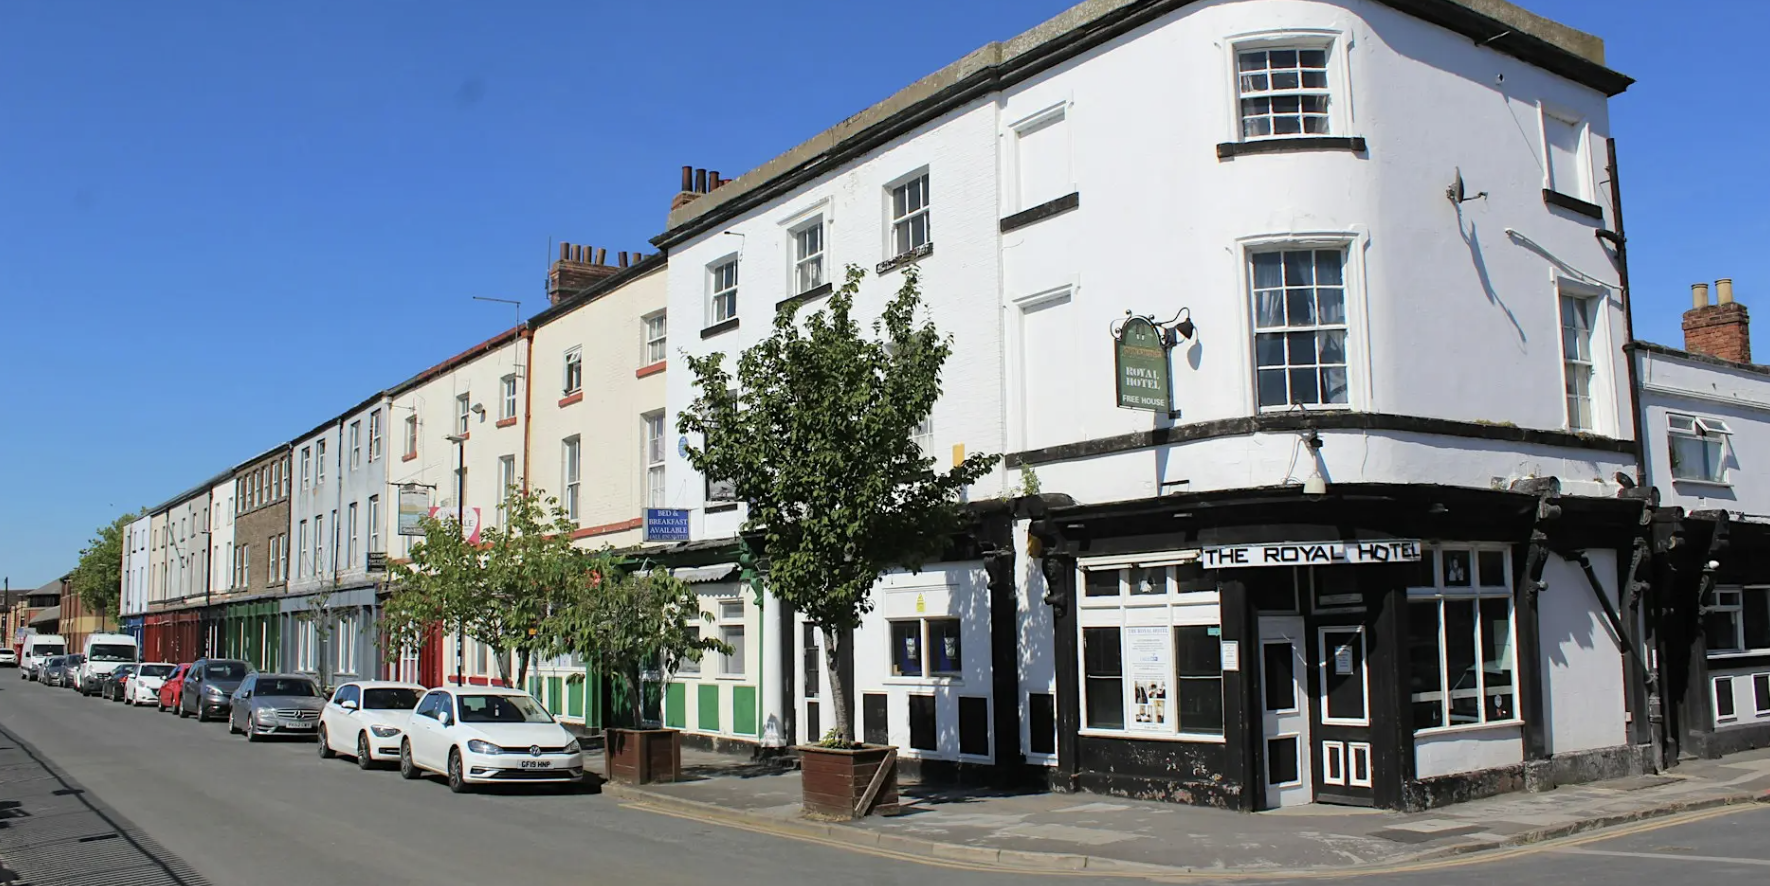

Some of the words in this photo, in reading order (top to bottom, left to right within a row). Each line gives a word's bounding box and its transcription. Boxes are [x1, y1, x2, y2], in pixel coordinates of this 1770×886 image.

[1126, 366, 1159, 380] ROYAL
[1126, 377, 1160, 390] HOTEL
[1122, 394, 1140, 404] FREE
[1141, 397, 1165, 406] HOUSE
[1205, 548, 1249, 566] THE
[1264, 545, 1345, 563] ROYAL
[1358, 541, 1421, 562] HOTEL
[521, 760, 536, 768] GF19
